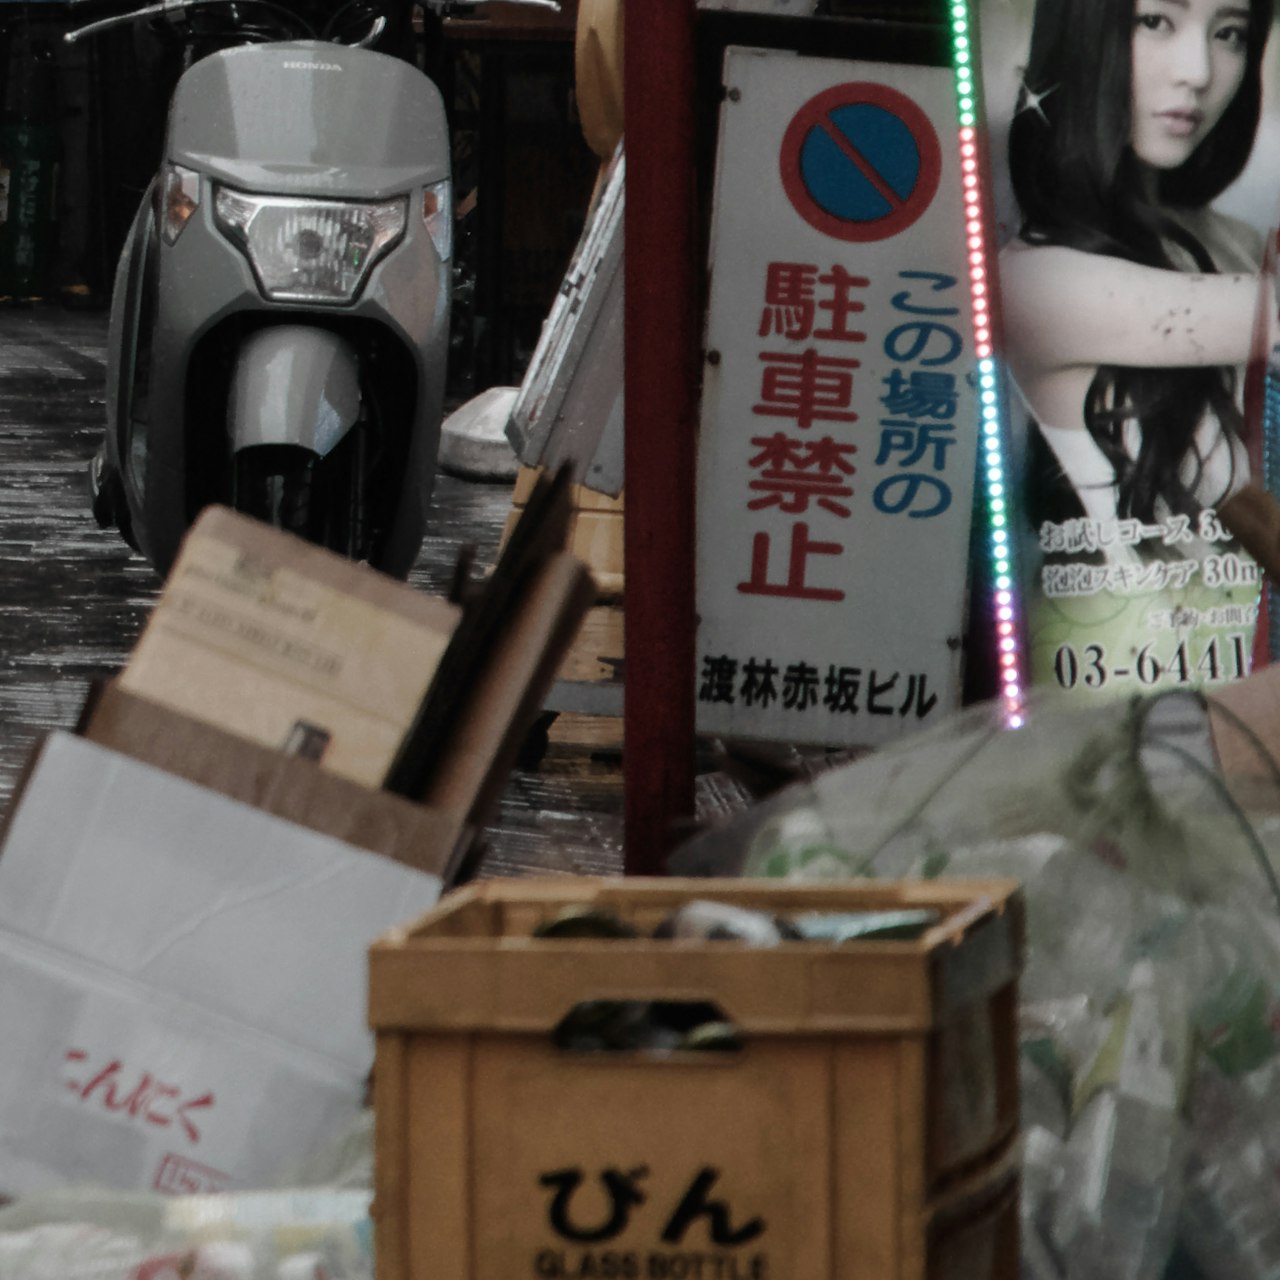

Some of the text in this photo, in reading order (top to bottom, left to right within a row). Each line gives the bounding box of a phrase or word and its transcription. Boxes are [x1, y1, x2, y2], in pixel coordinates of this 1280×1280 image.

[283, 60, 343, 72] HONDA
[736, 261, 871, 602] 駐車禁止
[871, 269, 963, 520] この場所の
[697, 653, 938, 722] 渡林赤坂ビル
[538, 1163, 766, 1245] びん
[536, 1251, 766, 1280] GLASS BOTTLE
